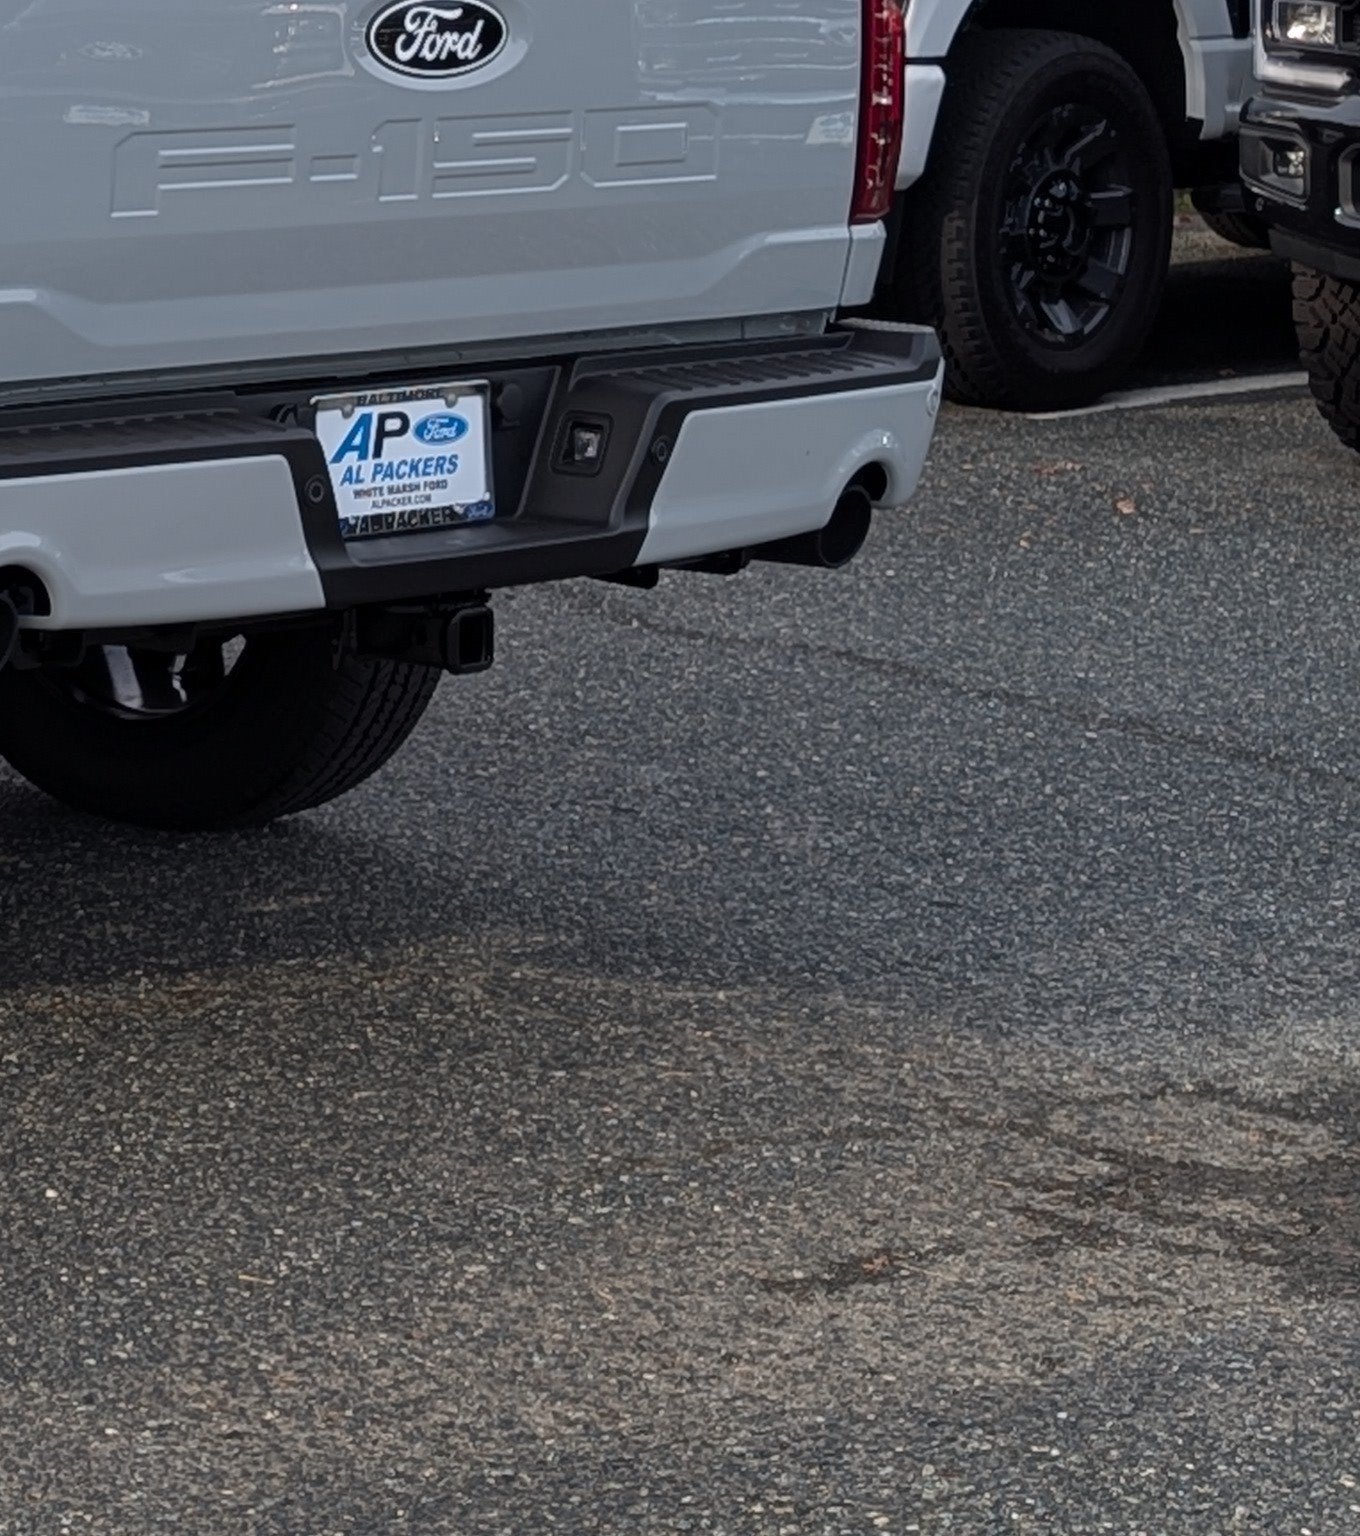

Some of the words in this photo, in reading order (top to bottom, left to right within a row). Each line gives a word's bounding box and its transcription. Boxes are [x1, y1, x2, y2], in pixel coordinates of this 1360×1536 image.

[394, 5, 486, 62] Ford
[111, 102, 722, 218] F-150
[330, 411, 411, 464] AP
[339, 464, 366, 487] AL
[370, 454, 460, 484] PACKERS
[352, 485, 386, 500] WHITE
[386, 481, 421, 496] MARSH
[423, 478, 449, 492] FORD
[370, 494, 433, 510] ALPACKER.COM
